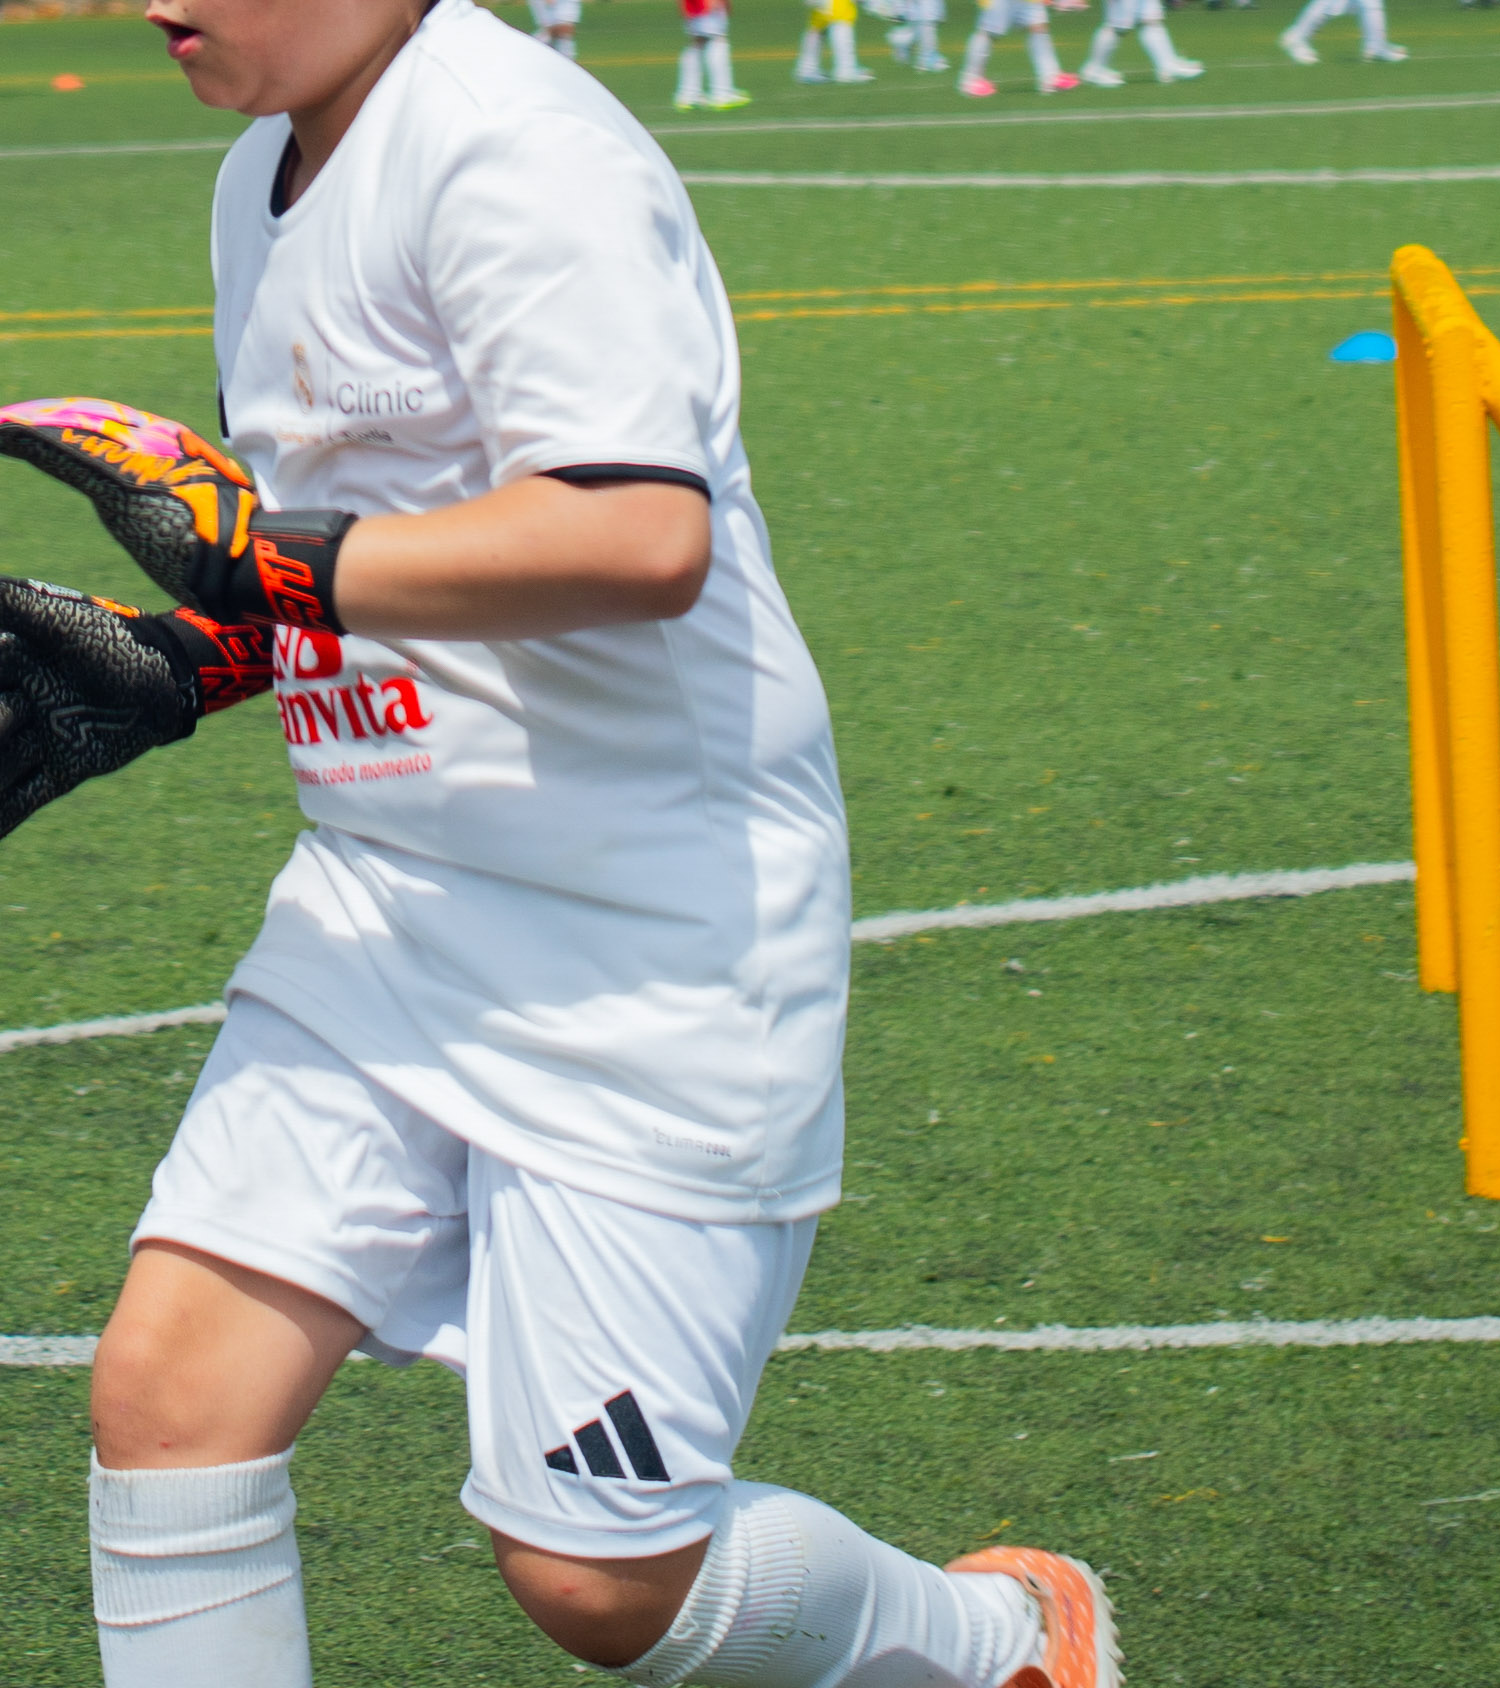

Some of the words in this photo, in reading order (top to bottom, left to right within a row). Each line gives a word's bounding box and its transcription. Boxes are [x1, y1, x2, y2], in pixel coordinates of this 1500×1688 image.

[337, 381, 424, 414] Clinic
[322, 759, 356, 786] cada
[359, 753, 433, 782] momento
